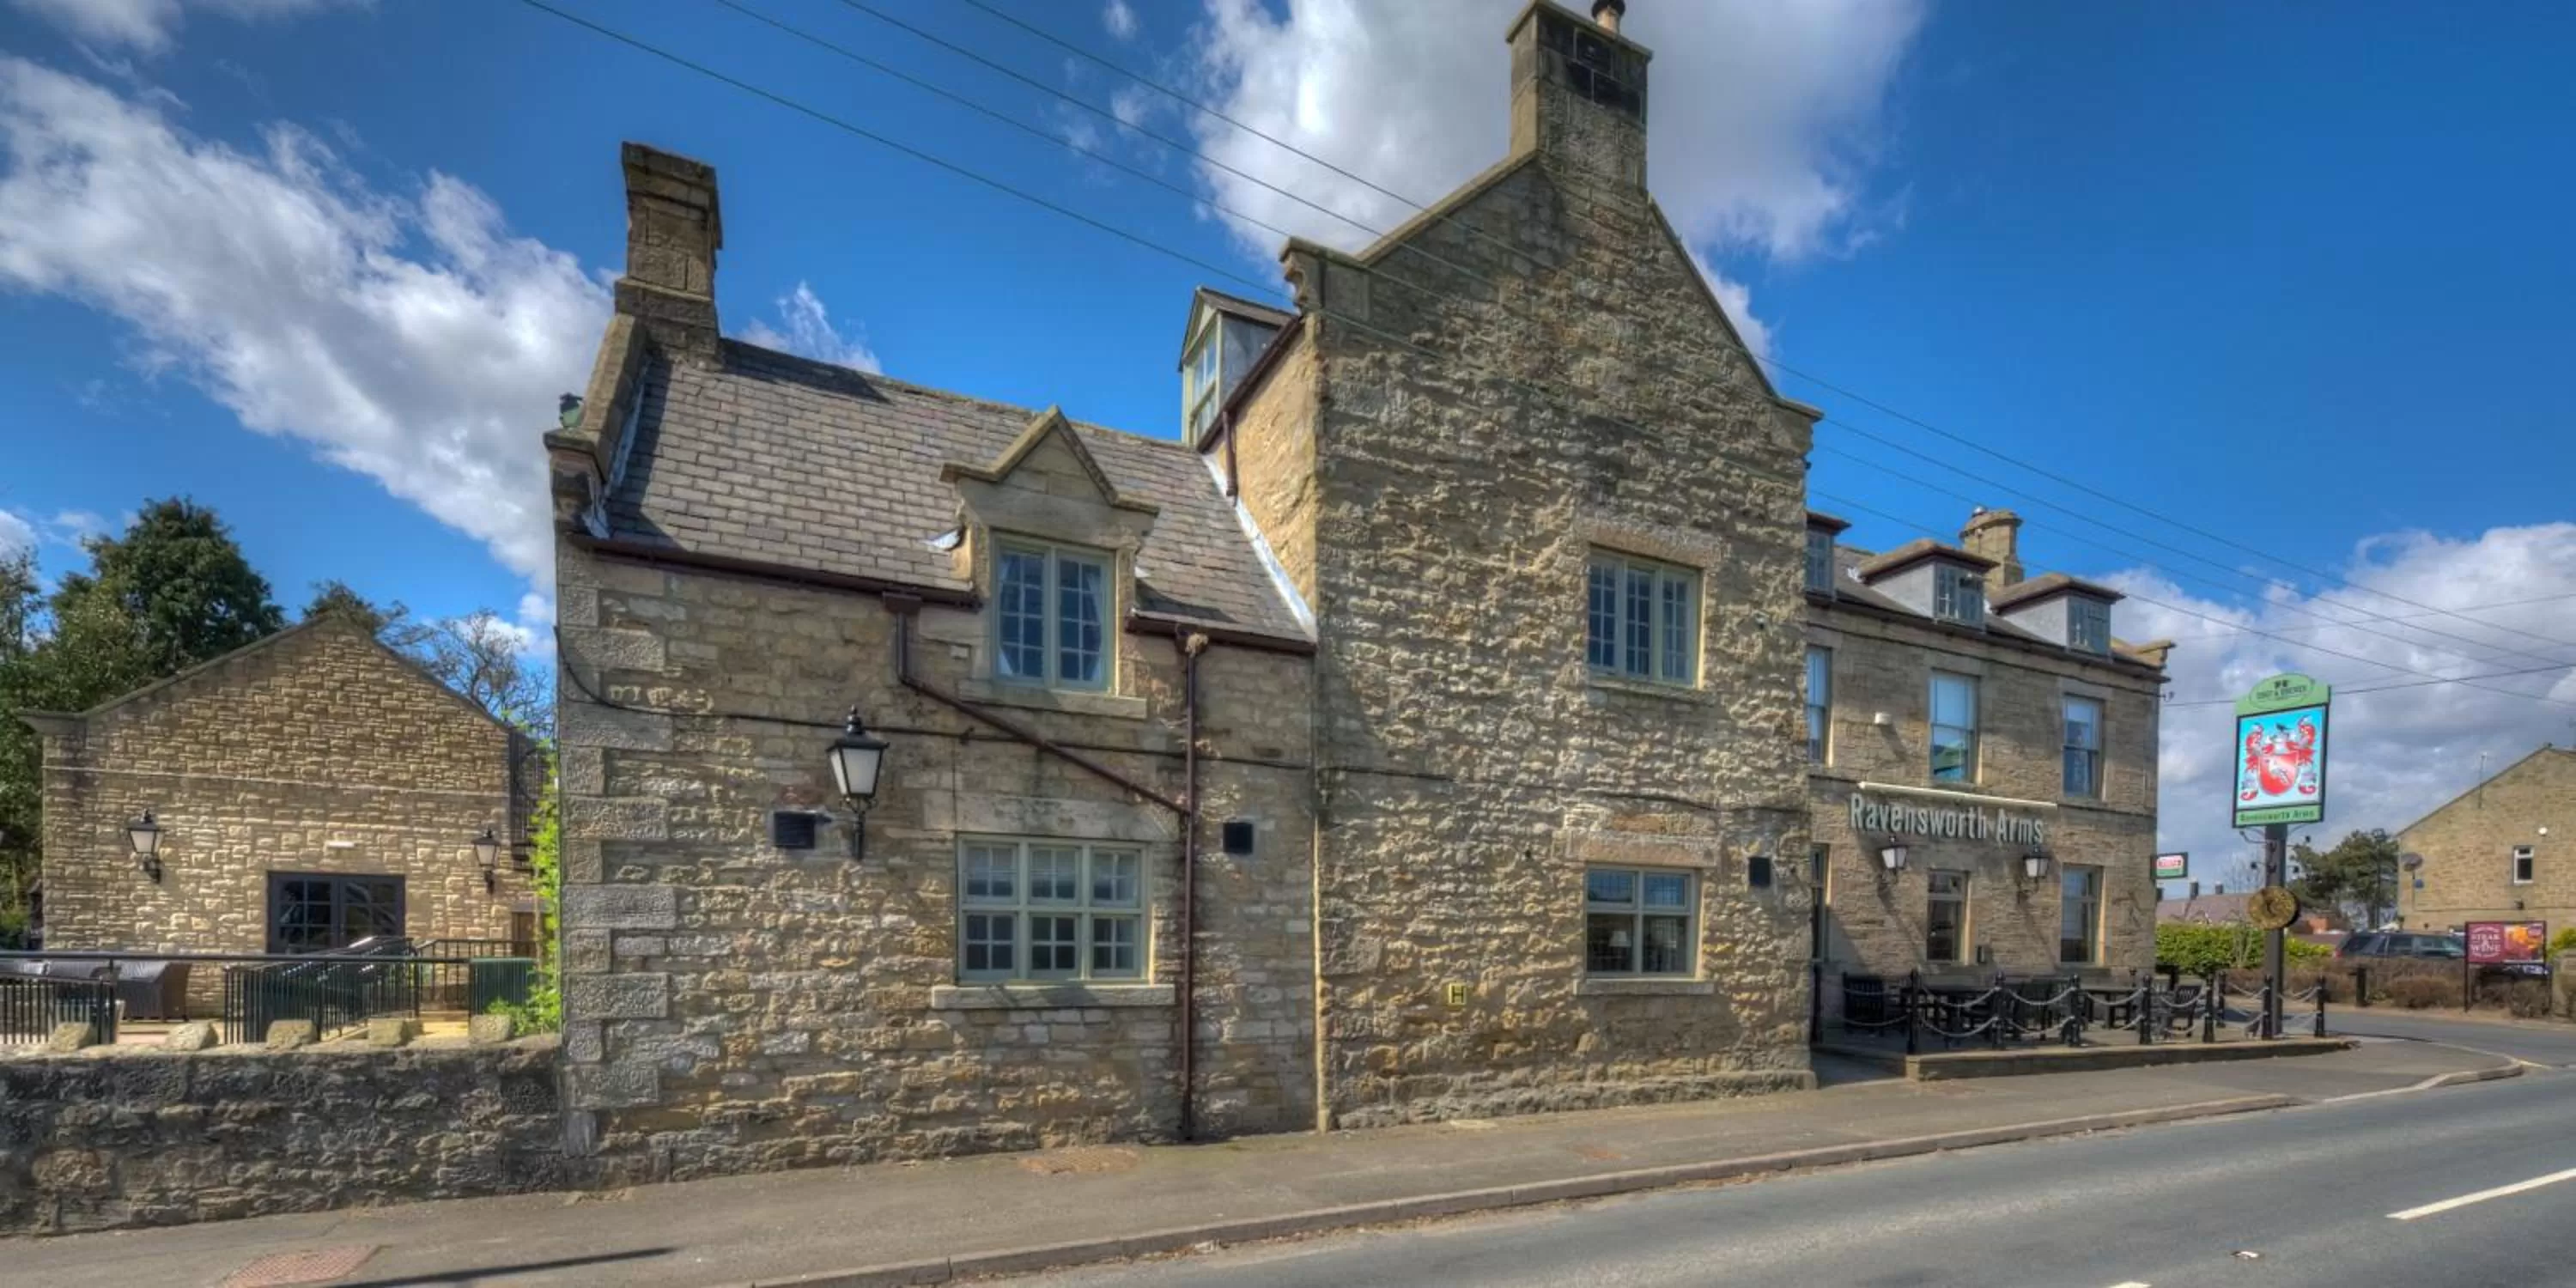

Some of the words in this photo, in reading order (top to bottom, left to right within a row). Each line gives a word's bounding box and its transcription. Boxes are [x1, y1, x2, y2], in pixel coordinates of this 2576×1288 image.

[1850, 793, 1987, 839] Ravensworth
[1996, 808, 2044, 843] Arms
[1451, 985, 1464, 1003] H
